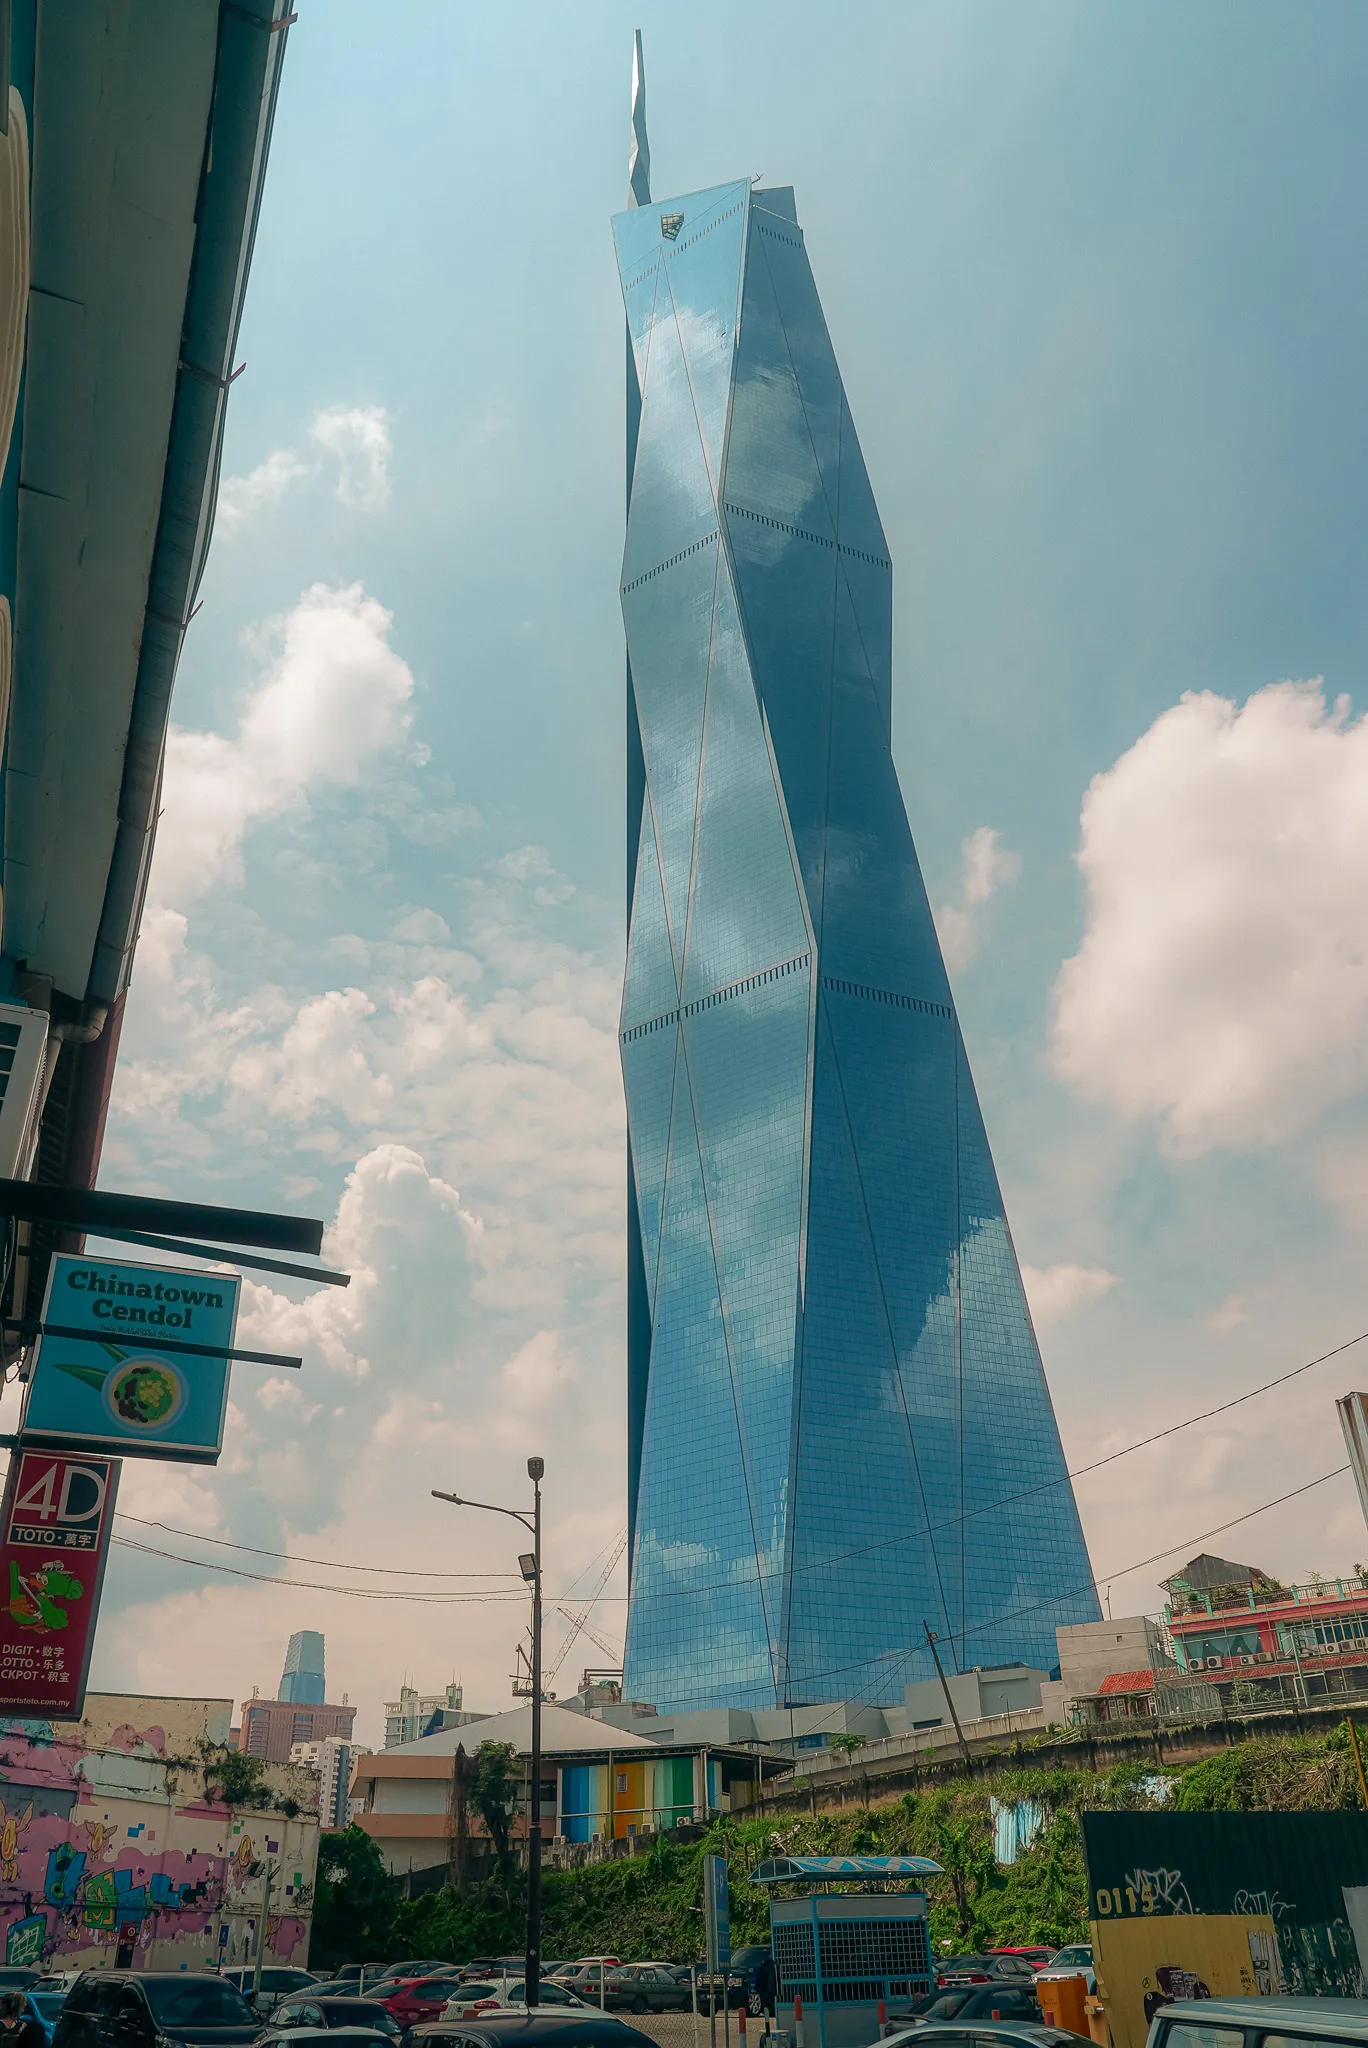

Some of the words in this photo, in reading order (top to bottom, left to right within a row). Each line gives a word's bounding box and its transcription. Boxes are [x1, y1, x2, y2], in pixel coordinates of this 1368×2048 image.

[67, 1270, 223, 1308] Chinatown
[92, 1298, 192, 1328] Cendol
[15, 1462, 106, 1522] 4D
[16, 1527, 55, 1543] TOTO
[64, 1533, 92, 1547] 萬字
[2, 1644, 34, 1656] DIGIT
[41, 1646, 65, 1658] 数字
[42, 1659, 65, 1671] 乐多
[47, 1671, 70, 1683] 积宝
[1096, 1884, 1154, 1915] 0115
